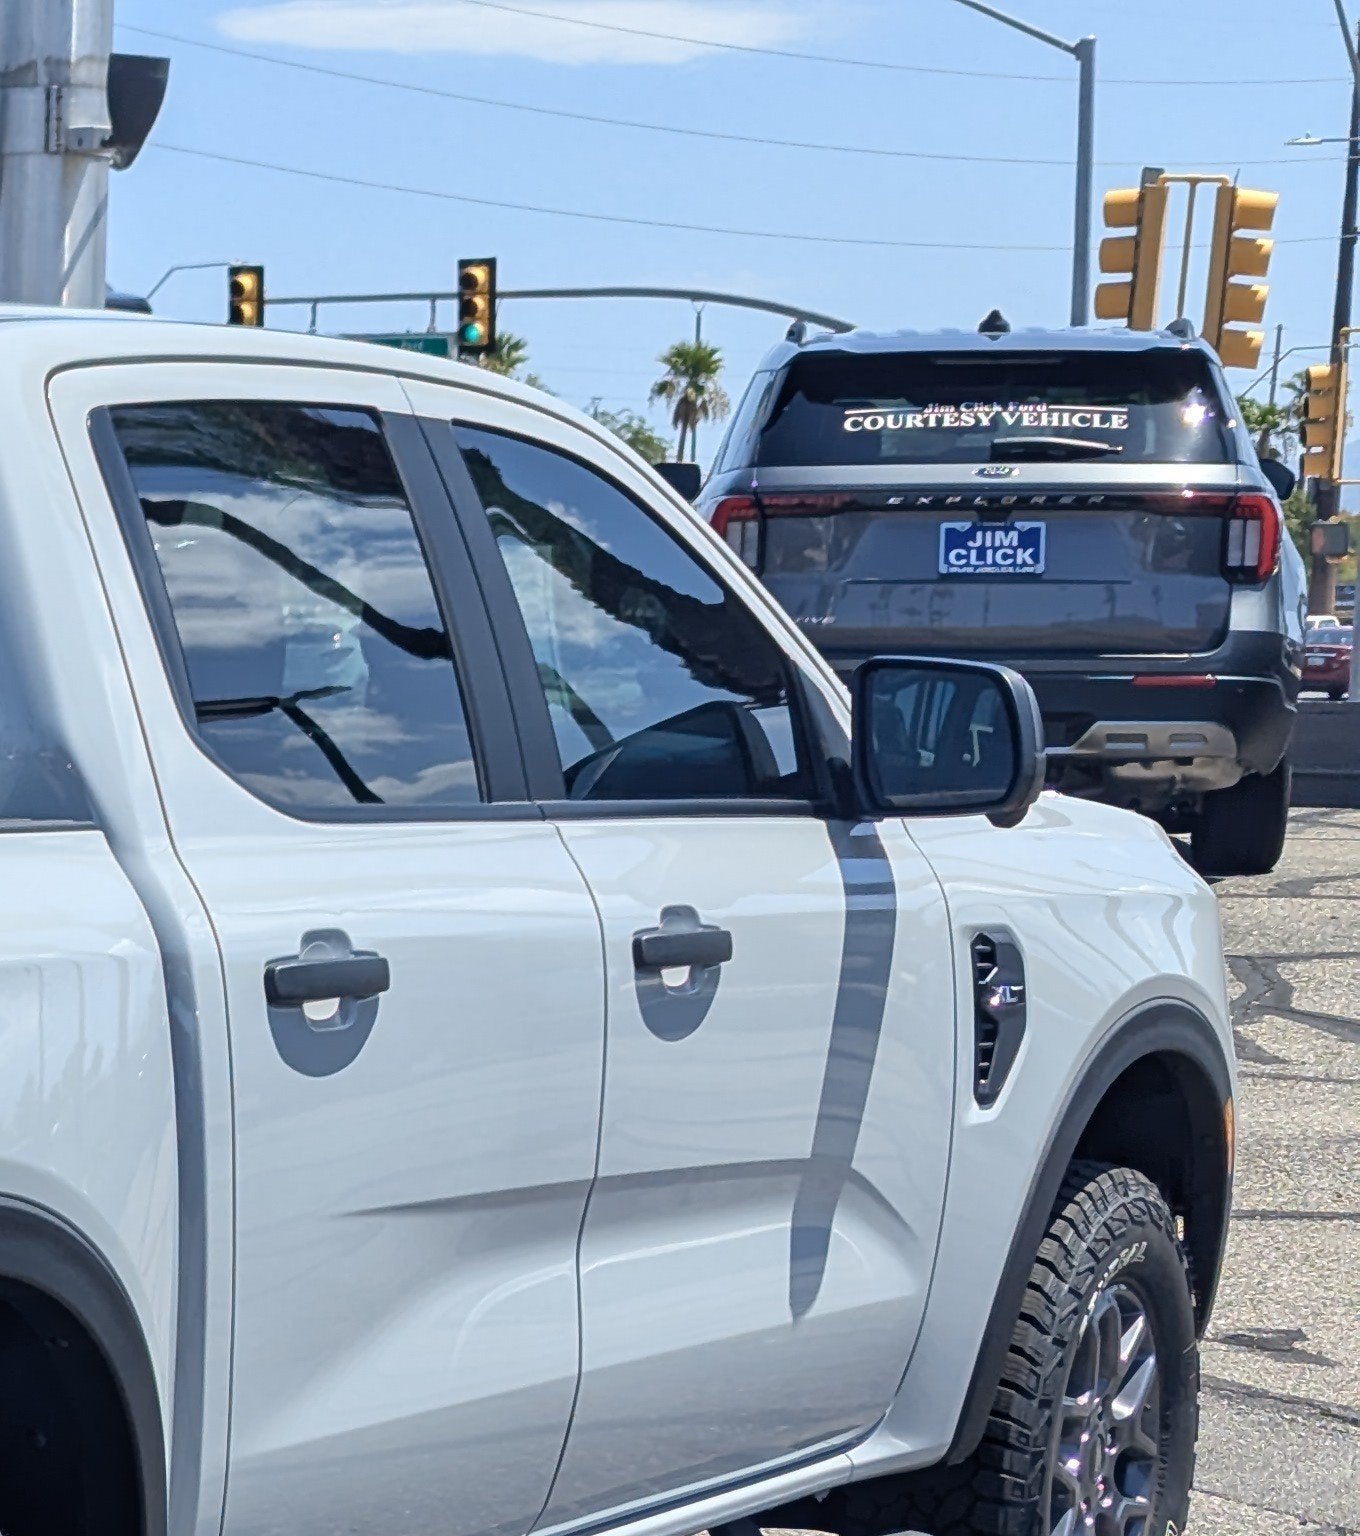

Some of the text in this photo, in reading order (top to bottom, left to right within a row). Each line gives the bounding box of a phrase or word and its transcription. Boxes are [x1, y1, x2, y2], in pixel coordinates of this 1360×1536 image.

[923, 401, 1048, 414] Jim Click Ford
[843, 411, 1129, 432] COURTESY VEHICLE
[886, 495, 1106, 506] EXPLORER
[966, 530, 1019, 548] JIM
[948, 548, 1035, 566] CLICK
